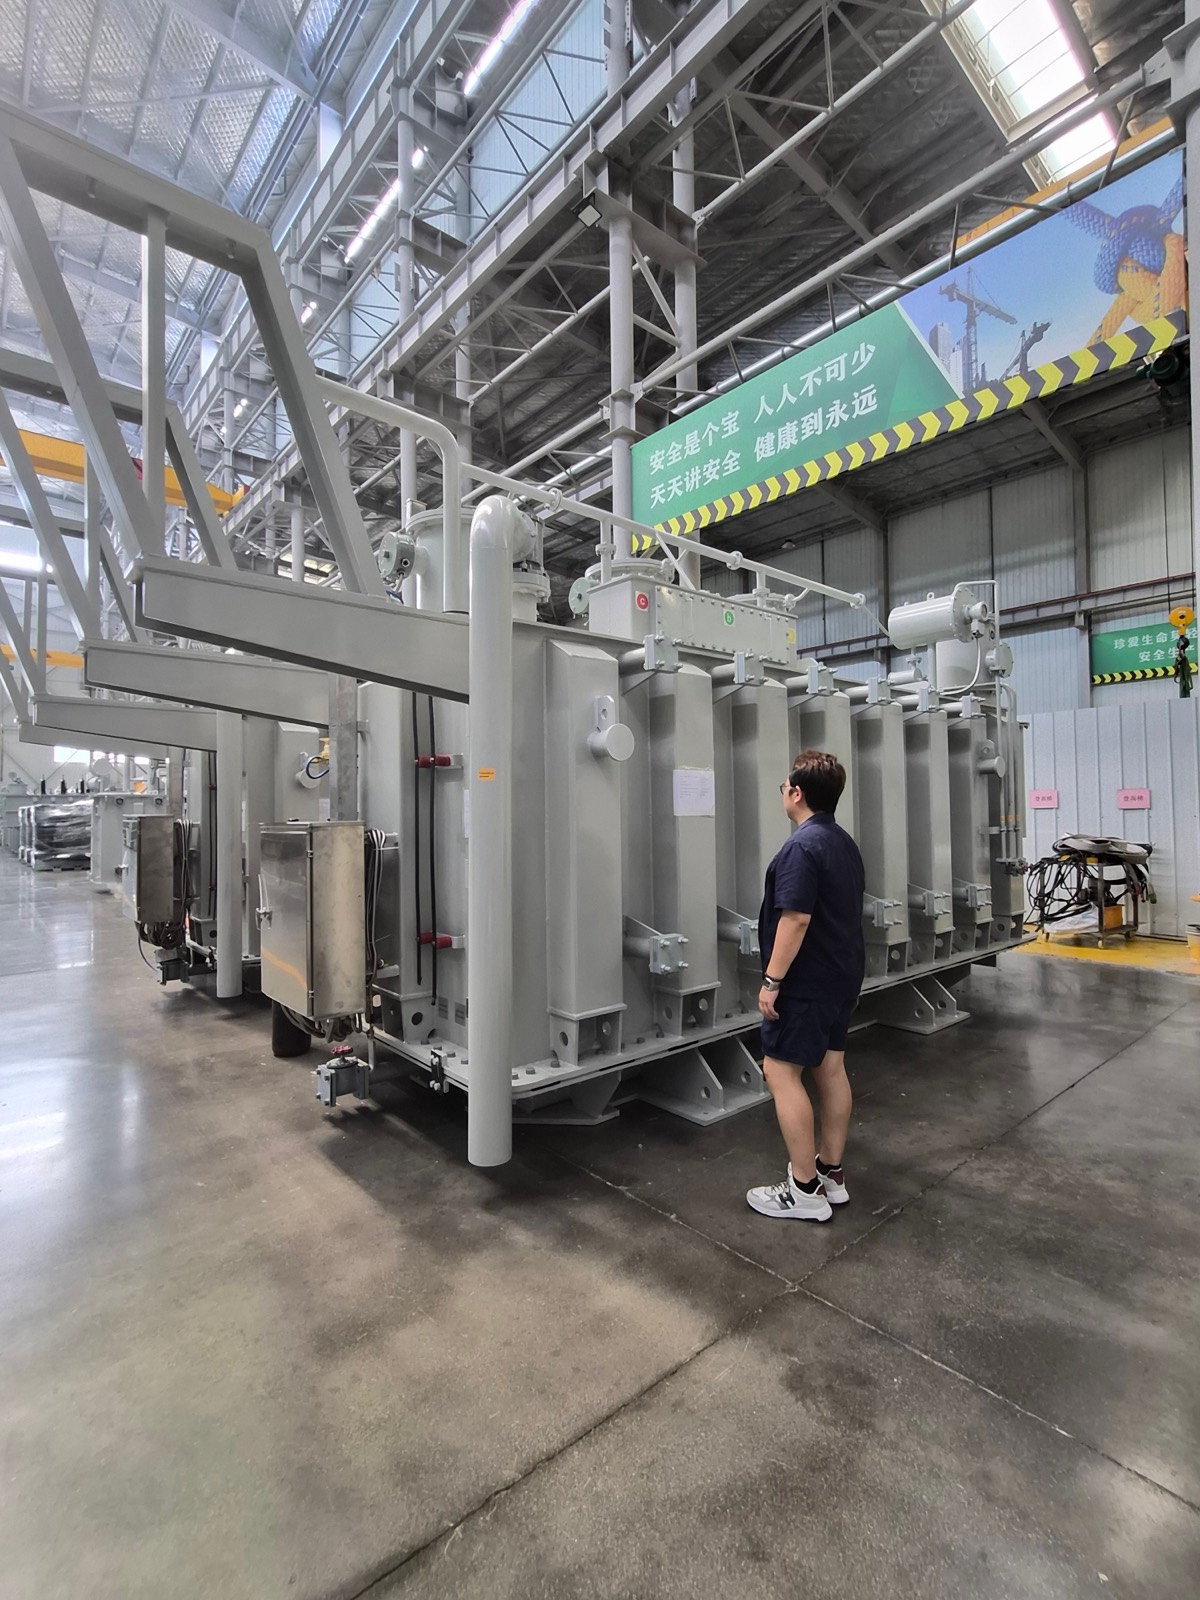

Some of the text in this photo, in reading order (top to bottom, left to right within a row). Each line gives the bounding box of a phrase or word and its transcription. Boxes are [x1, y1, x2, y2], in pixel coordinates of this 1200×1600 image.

[649, 341, 876, 475] 安全是个宝 人人不可少
[650, 383, 878, 509] 天天讲安全 健康到永远
